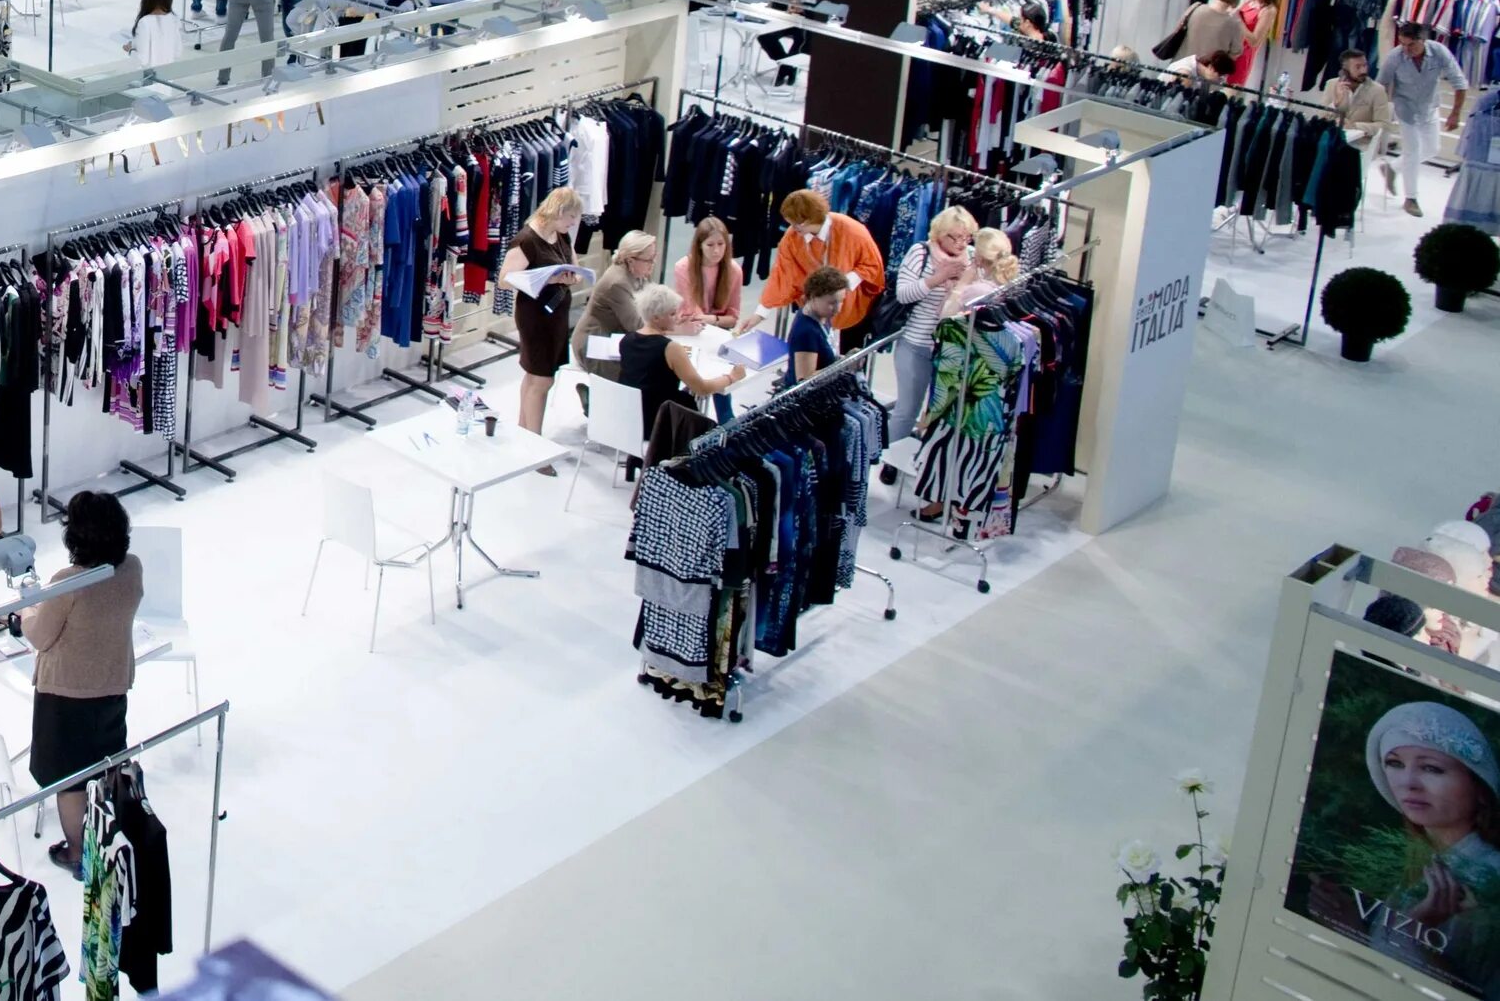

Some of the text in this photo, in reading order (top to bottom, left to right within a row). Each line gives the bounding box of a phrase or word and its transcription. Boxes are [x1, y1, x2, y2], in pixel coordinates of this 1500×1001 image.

[1152, 275, 1190, 312] MODA
[1130, 299, 1188, 354] ITALIA
[1351, 887, 1448, 954] VIZIO
